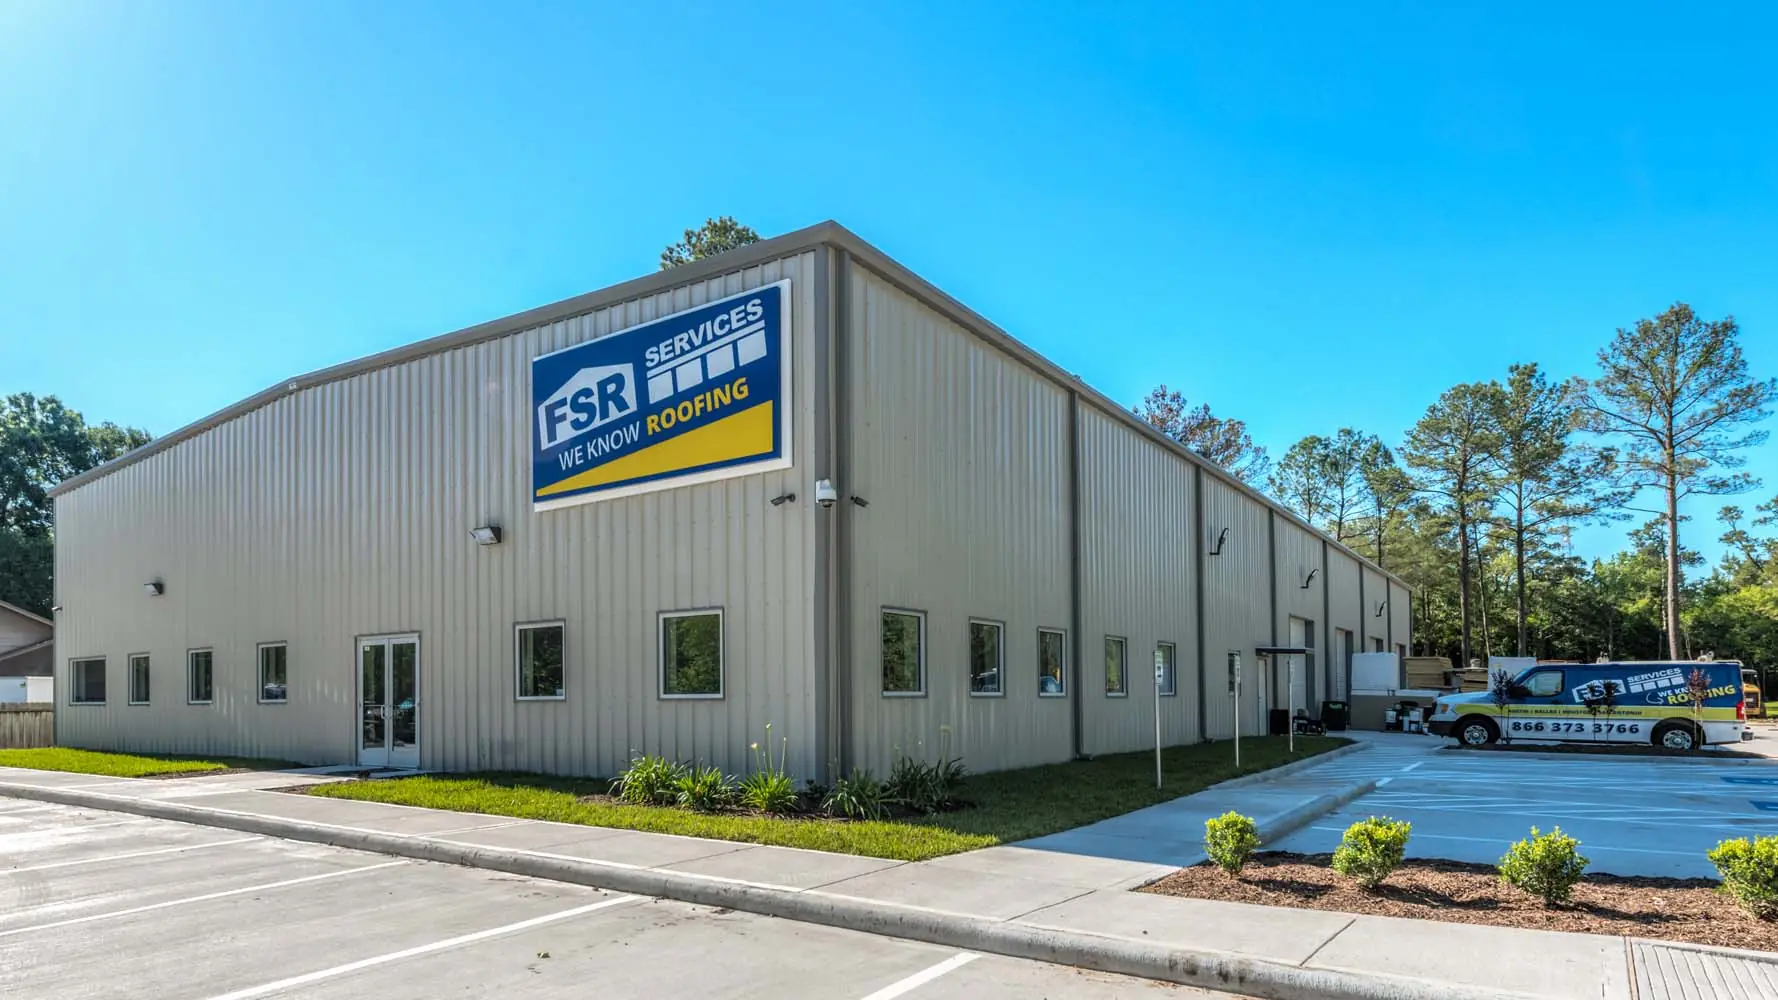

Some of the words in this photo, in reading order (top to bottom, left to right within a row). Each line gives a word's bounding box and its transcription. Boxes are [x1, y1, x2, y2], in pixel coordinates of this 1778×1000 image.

[645, 298, 764, 368] SERVICES
[544, 373, 632, 444] FSR
[558, 447, 584, 471] WE
[587, 421, 641, 461] KNOW
[646, 377, 750, 436] ROOFING
[1627, 667, 1682, 683] SERVICES
[1657, 689, 1673, 697] WE
[1667, 684, 1736, 704] ROING
[1512, 721, 1545, 732] 866
[1551, 722, 1585, 733] 373
[1593, 723, 1640, 734] 3766
